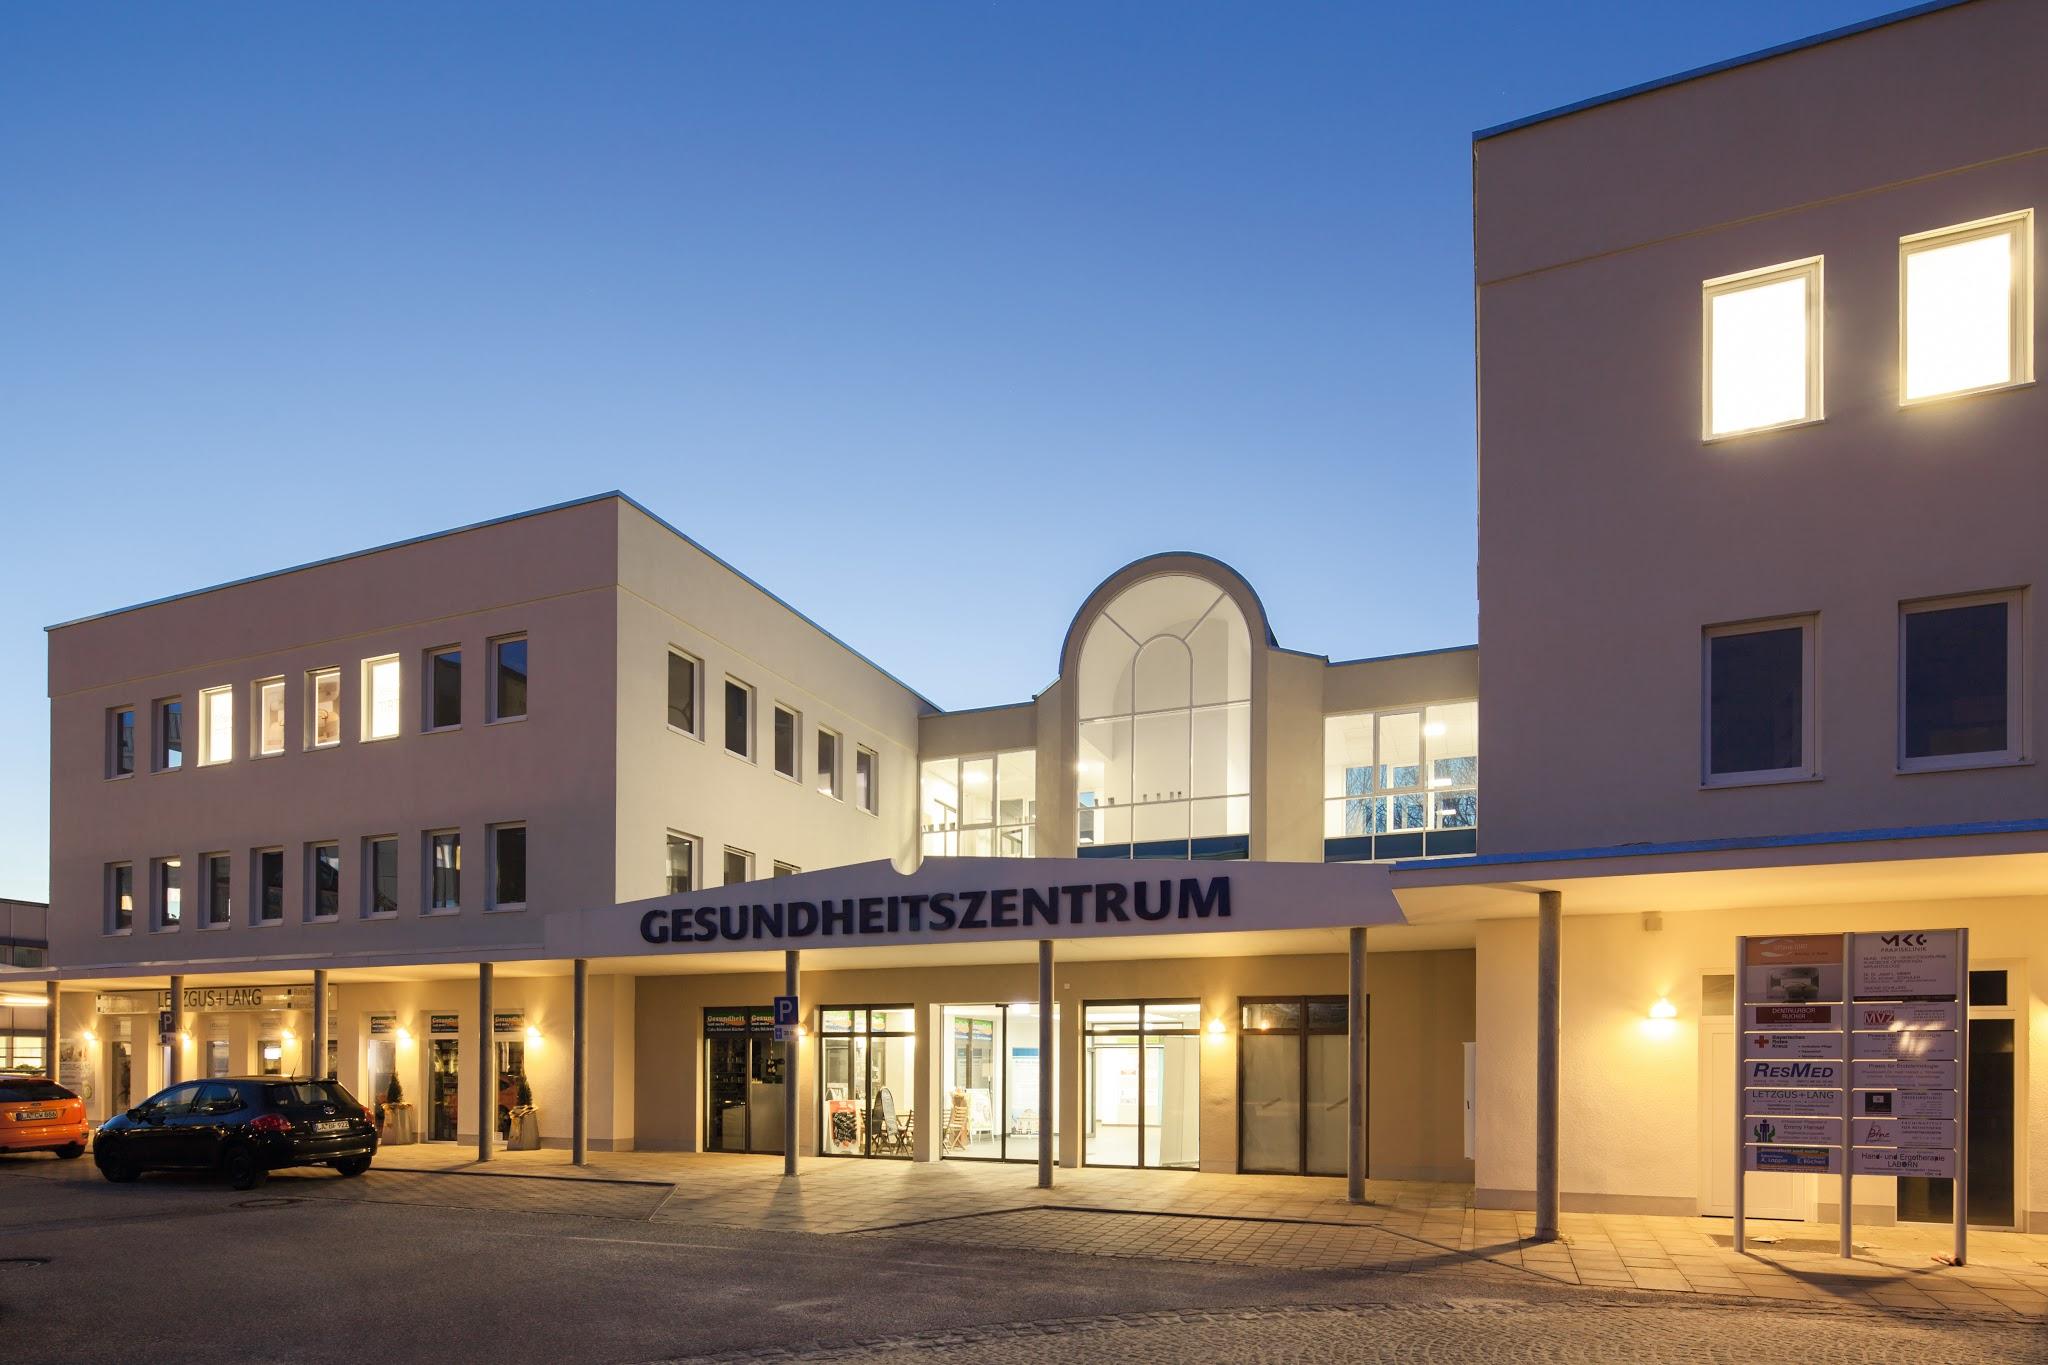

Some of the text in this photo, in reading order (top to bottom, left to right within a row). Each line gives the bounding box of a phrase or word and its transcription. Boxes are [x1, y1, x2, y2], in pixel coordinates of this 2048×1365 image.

[639, 876, 1231, 944] GESUNDHEITSZENTRUM
[158, 988, 262, 1008] LEZGUS+LANG
[780, 1000, 792, 1022] P
[1864, 1013, 1894, 1025] MVZ
[164, 1014, 172, 1030] P
